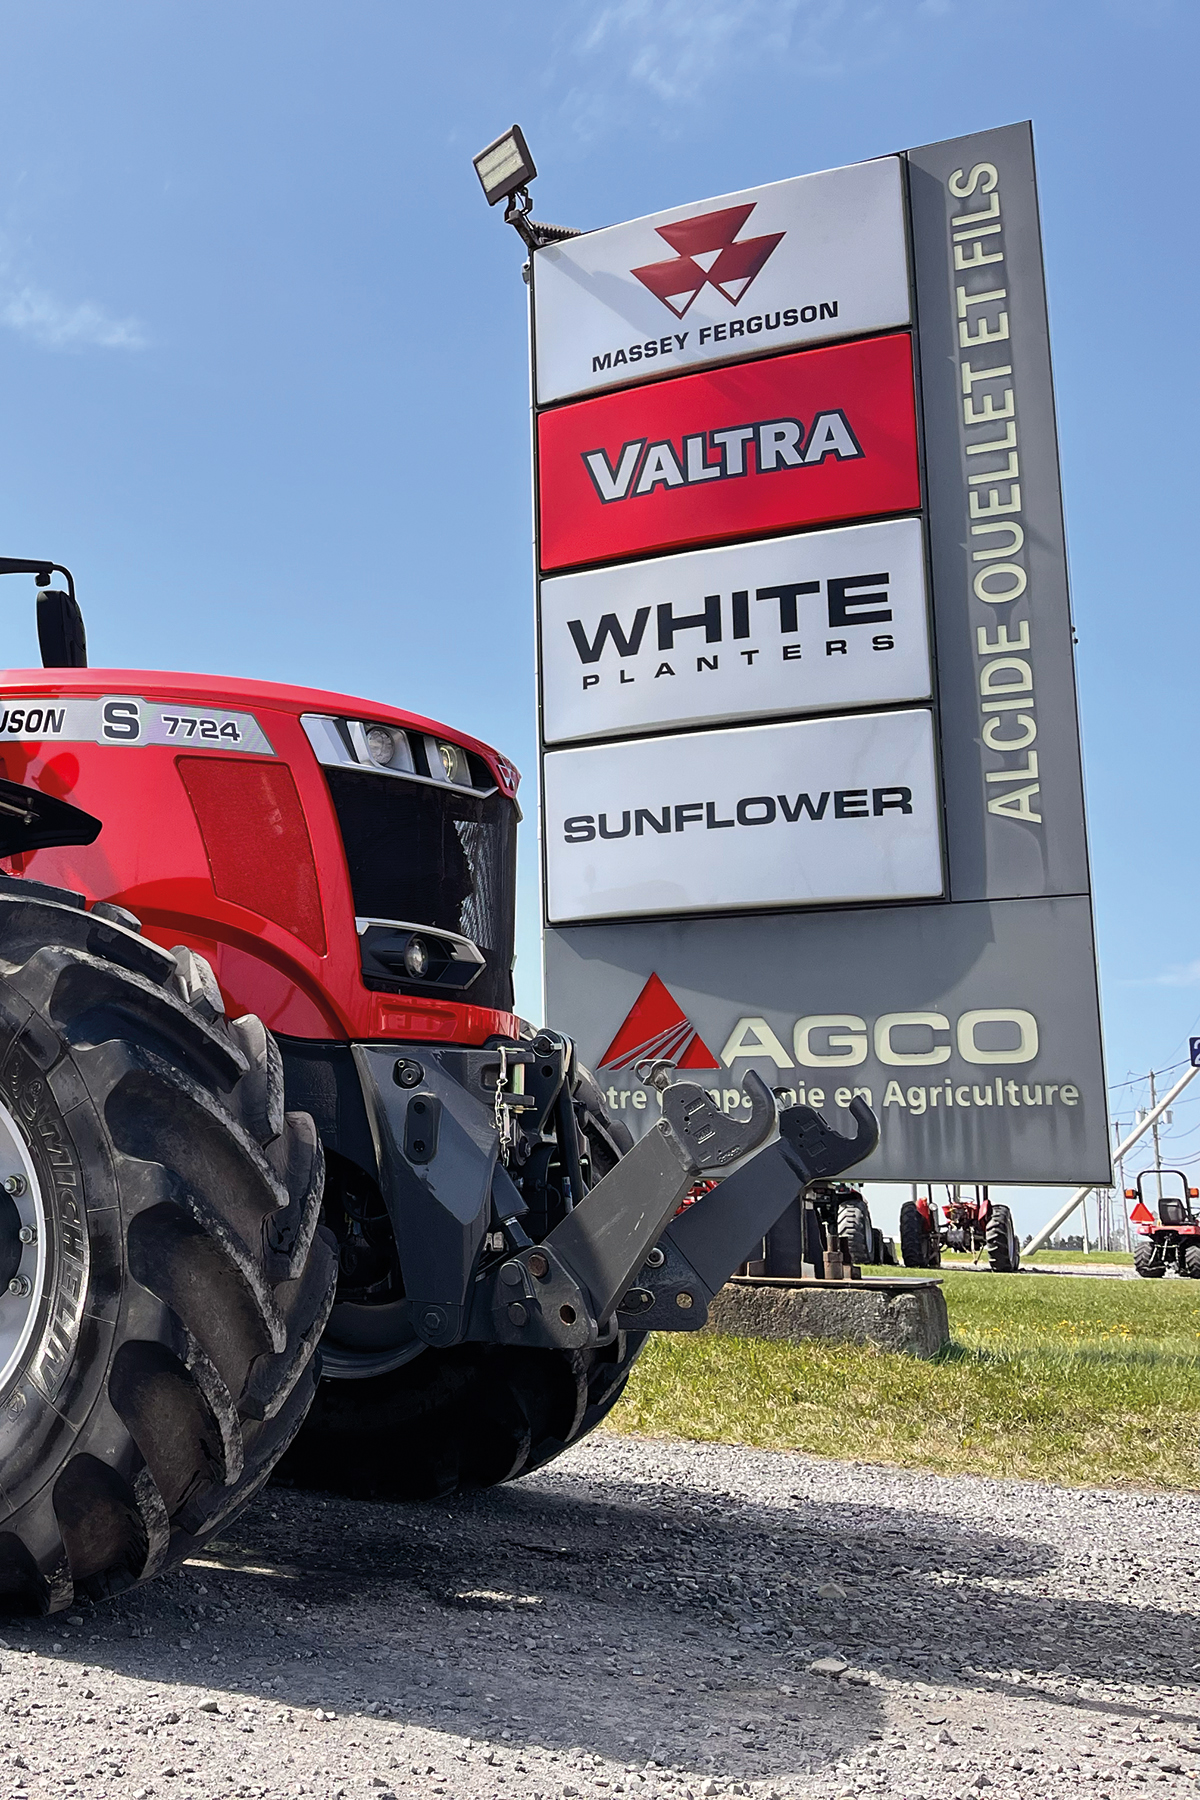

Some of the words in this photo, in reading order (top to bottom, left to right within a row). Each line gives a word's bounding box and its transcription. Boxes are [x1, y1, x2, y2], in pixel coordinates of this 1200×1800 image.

[948, 161, 1004, 271] FILS
[592, 331, 689, 373] MASSEY
[699, 301, 839, 346] FERGUSON
[956, 286, 1010, 348] ET
[583, 411, 861, 503] VALTRA
[960, 361, 1028, 604] OUELLET
[567, 572, 893, 664] WHITE
[582, 634, 895, 690] PLANTERS
[102, 702, 139, 740] S
[161, 715, 241, 742] 7724
[977, 620, 1042, 824] ALCIDE
[563, 785, 913, 844] SUNFLOWER
[719, 1007, 1040, 1069] AGCO
[601, 1085, 648, 1110] tre
[882, 1077, 1080, 1116] Agriculture
[30, 1119, 87, 1402] MICHELIN
